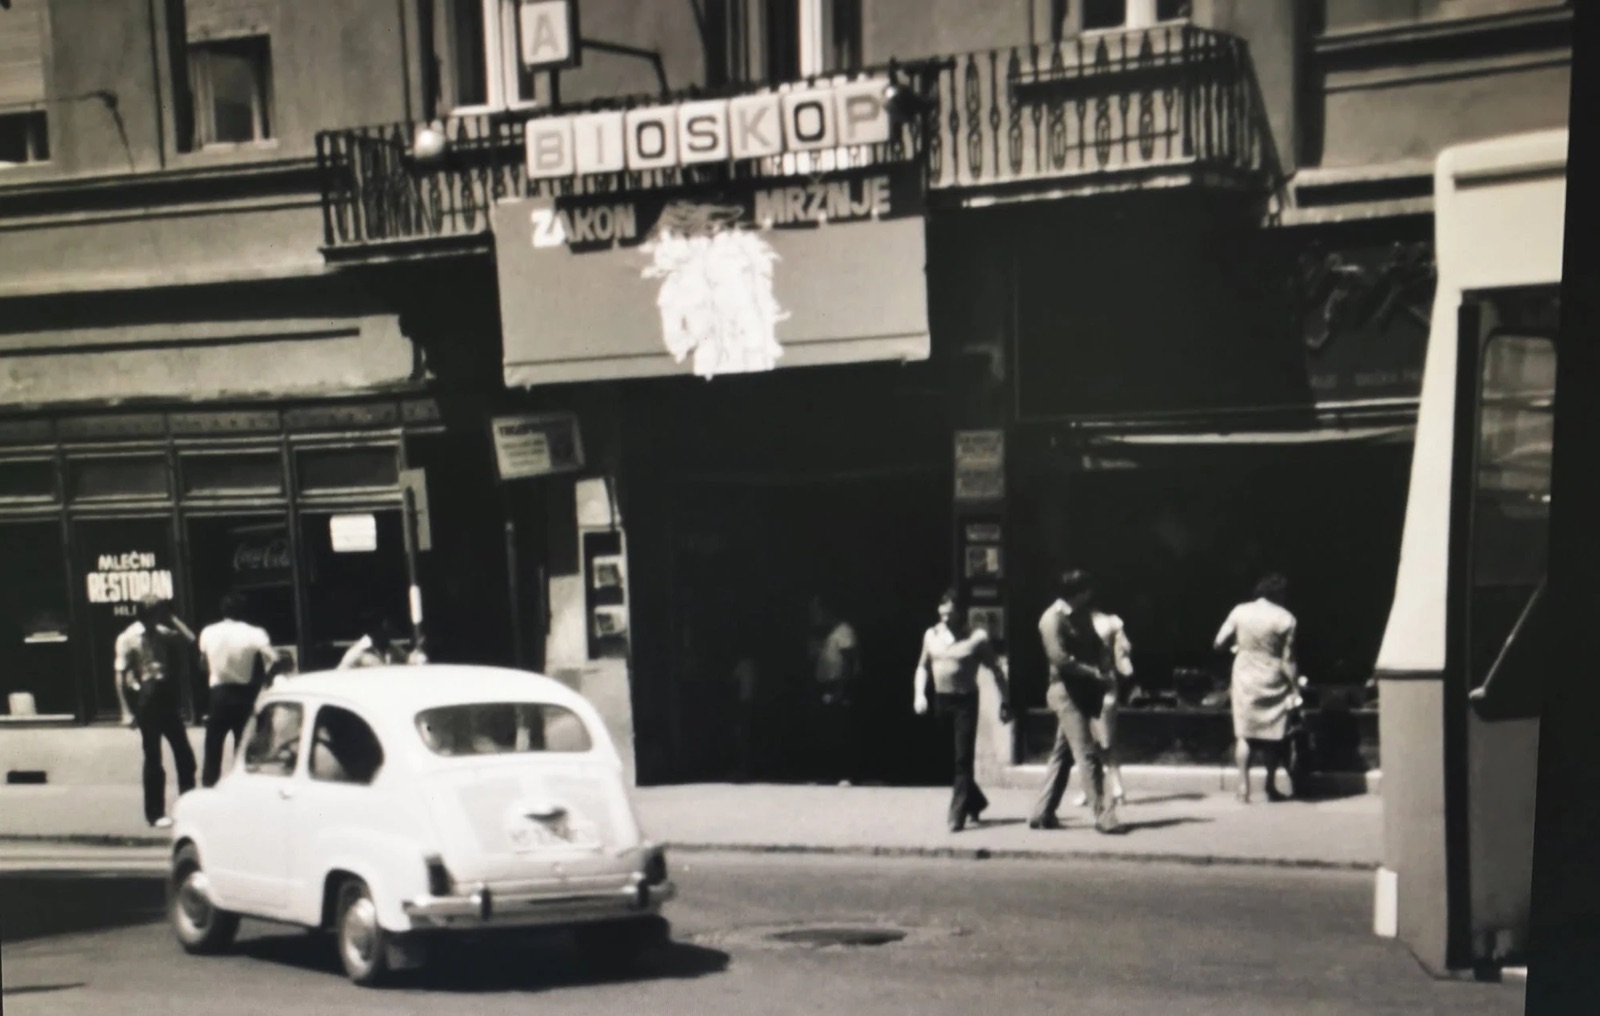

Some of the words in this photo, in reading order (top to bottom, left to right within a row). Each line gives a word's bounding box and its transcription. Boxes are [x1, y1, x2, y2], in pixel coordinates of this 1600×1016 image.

[531, 14, 561, 55] A
[534, 95, 882, 171] BIOSKOP
[531, 203, 636, 248] ZAKON
[755, 174, 890, 226] MRŽNJE
[98, 550, 156, 571] MLEČNI
[87, 569, 174, 603] RESTORAN
